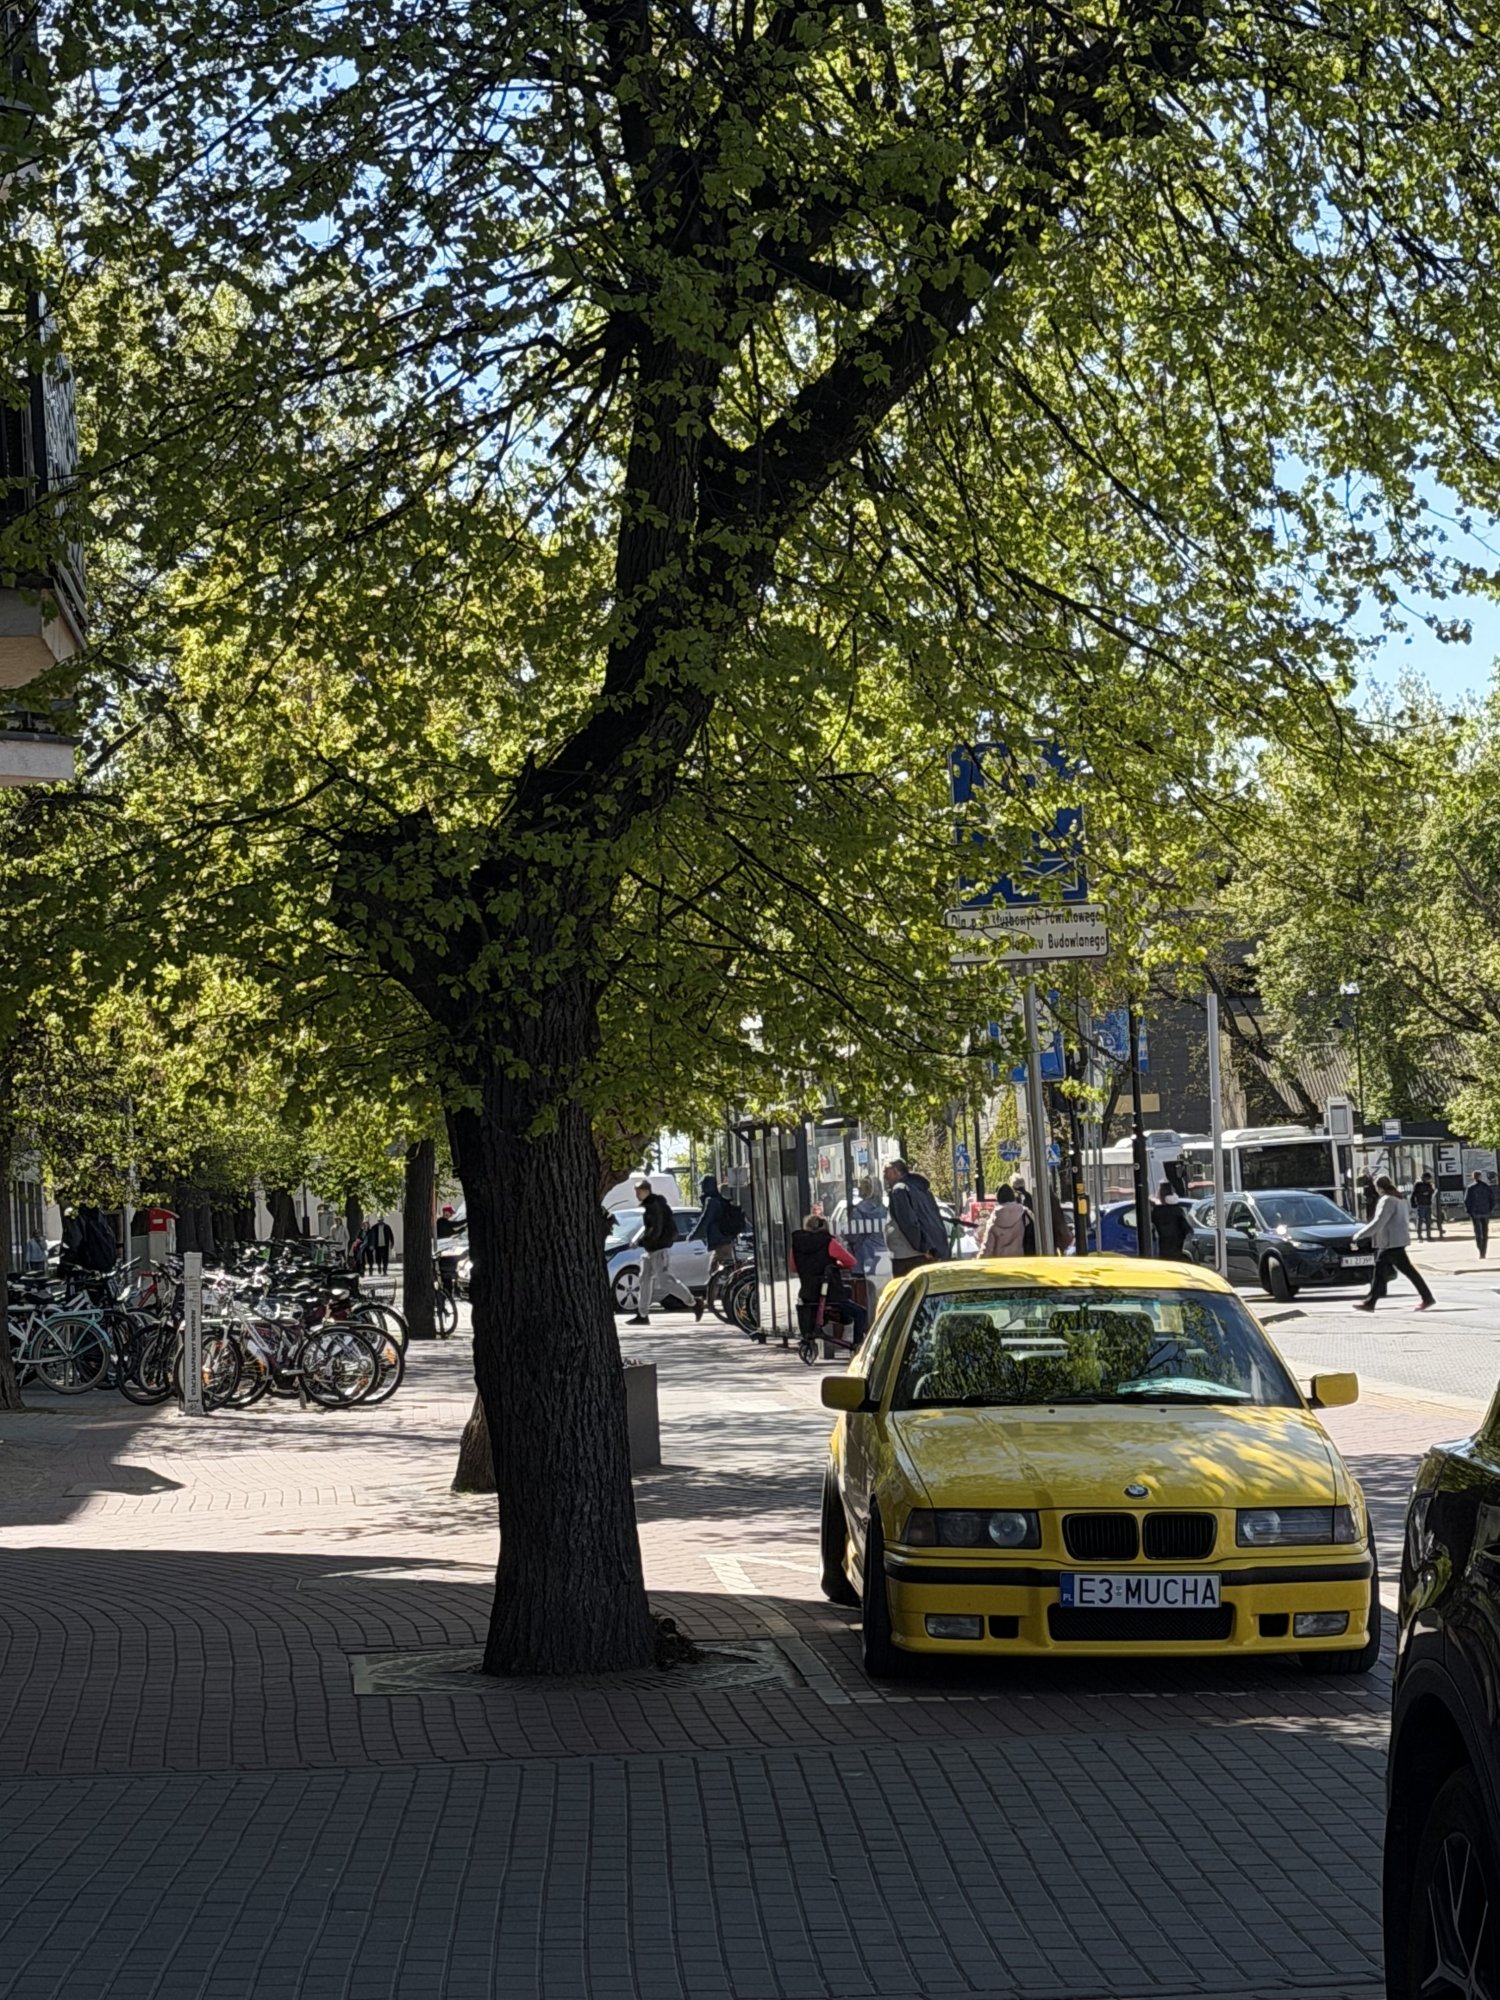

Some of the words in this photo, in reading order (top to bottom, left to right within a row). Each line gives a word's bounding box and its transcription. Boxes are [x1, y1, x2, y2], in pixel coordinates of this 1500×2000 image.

[1048, 932, 1106, 952] Budowlanego
[1063, 1593, 1073, 1602] PL
[1079, 1577, 1113, 1605] E3
[1125, 1578, 1216, 1605] MUCHA
